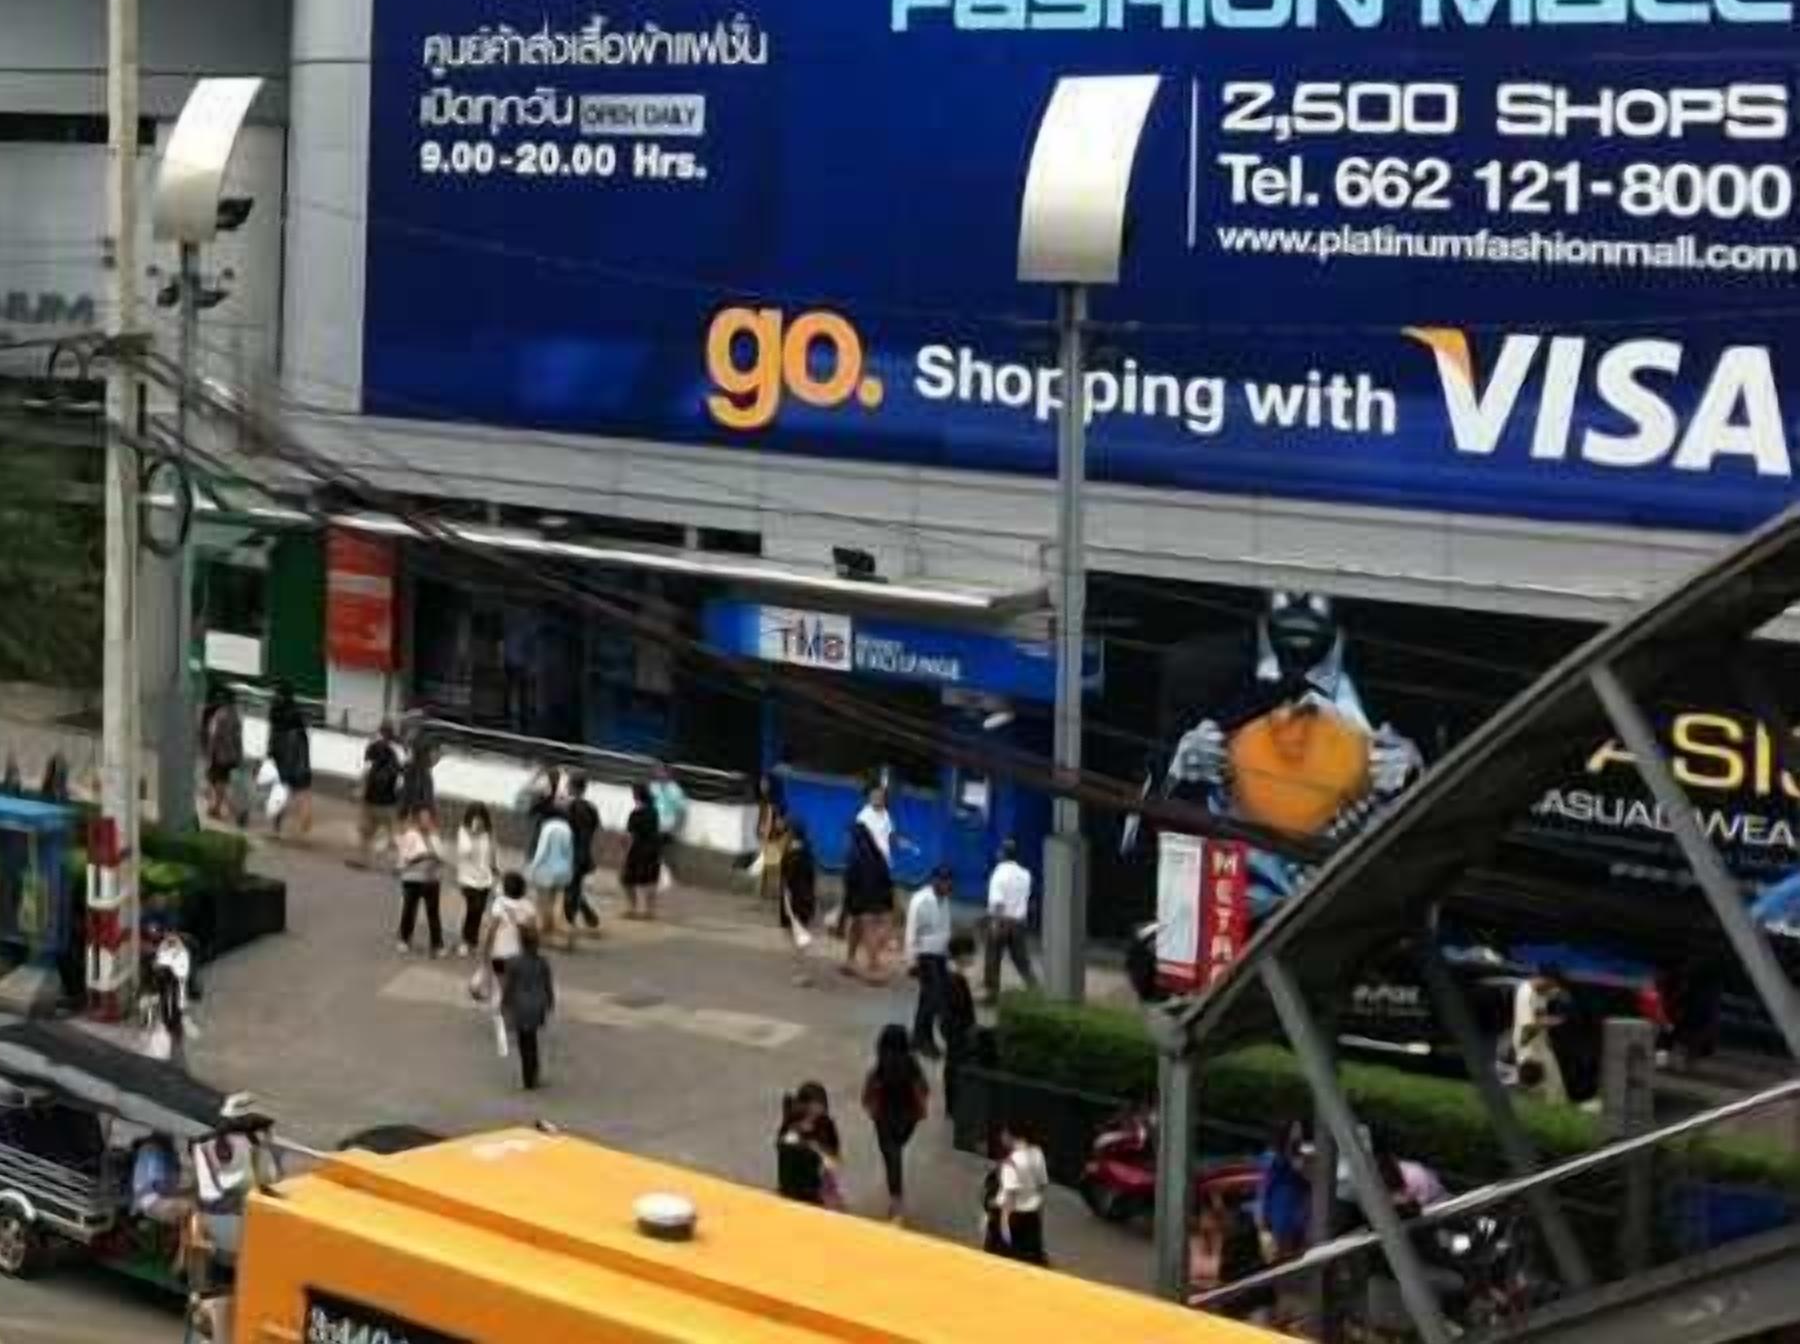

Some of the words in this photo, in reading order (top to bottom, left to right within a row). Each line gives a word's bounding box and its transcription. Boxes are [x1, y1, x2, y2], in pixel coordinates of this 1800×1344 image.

[1222, 82, 1459, 141] 2,500
[1497, 83, 1789, 139] SHOPS
[419, 140, 617, 176] 9.00-20.00
[633, 142, 707, 179] Hrs.
[1219, 153, 1319, 207] Tel.
[1335, 157, 1452, 210] 662
[1473, 160, 1793, 219] 121-8000
[1218, 225, 1798, 273] www.platinumfashionmall.com
[706, 306, 883, 428] go.
[915, 345, 1224, 434] Shopping
[1244, 369, 1396, 434] with
[1402, 325, 1791, 477] VISA
